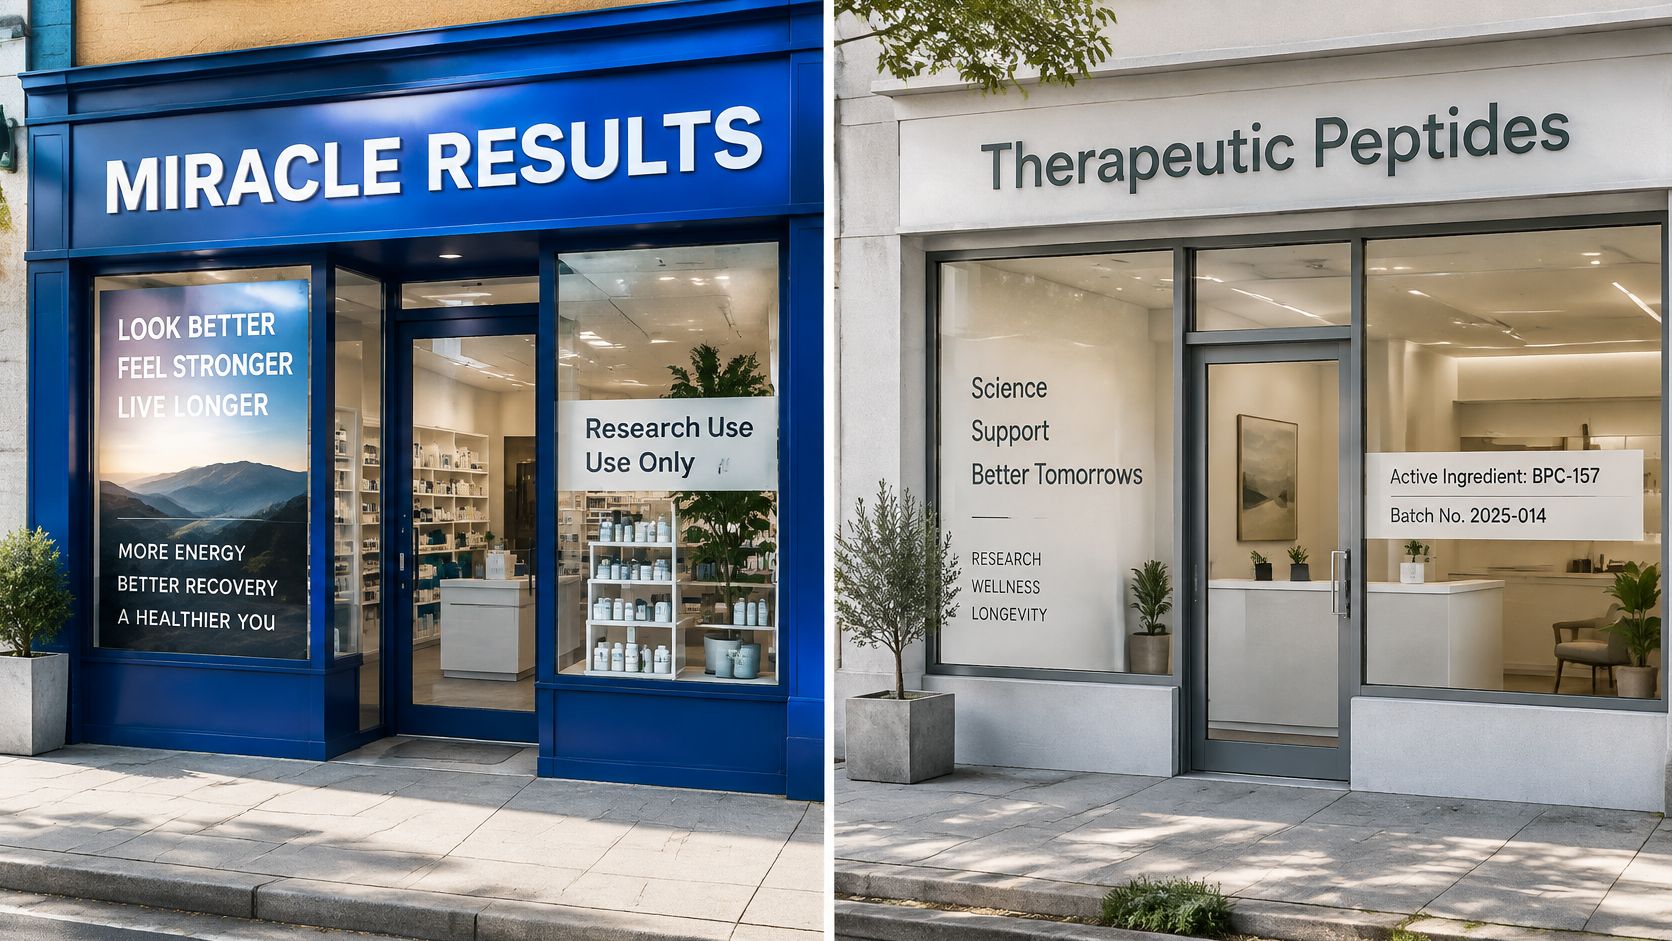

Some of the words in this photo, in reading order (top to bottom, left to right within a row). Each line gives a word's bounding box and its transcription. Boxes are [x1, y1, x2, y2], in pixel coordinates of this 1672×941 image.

[981, 122, 1294, 194] Therapeutic
[1316, 102, 1570, 176] Peptides
[106, 136, 402, 214] MIRACLE
[429, 105, 763, 192] RESULTS
[118, 316, 181, 341] LOOK
[188, 312, 275, 338] BETTER
[118, 356, 167, 379] FEEL
[173, 352, 293, 378] STRONGER
[972, 377, 1047, 399] Science
[118, 395, 166, 418] LIVE
[175, 393, 268, 417] LONGER
[586, 416, 699, 438] Research
[709, 417, 753, 437] Use
[972, 420, 1049, 447] Support
[586, 452, 630, 472] Use
[639, 451, 695, 478] Only
[972, 463, 1030, 485] Better
[1034, 463, 1143, 485] Tomorrows
[1391, 469, 1438, 484] Active
[1443, 468, 1527, 487] Ingredient:
[1533, 468, 1600, 484] BPC-157
[1391, 508, 1433, 523] Batch
[1440, 508, 1464, 523] No.
[1471, 508, 1546, 523] 2025-014
[119, 543, 168, 560] MORE
[176, 544, 246, 561] ENERGY
[972, 552, 1041, 566] RESEARCH
[118, 576, 179, 593] BETTER
[186, 578, 278, 596] RECOVERY
[972, 579, 1041, 594] WELLNESS
[118, 609, 129, 625] A
[136, 610, 230, 629] HEALTHIER
[238, 613, 275, 631] YOU
[972, 607, 1047, 622] LONGEVITY
